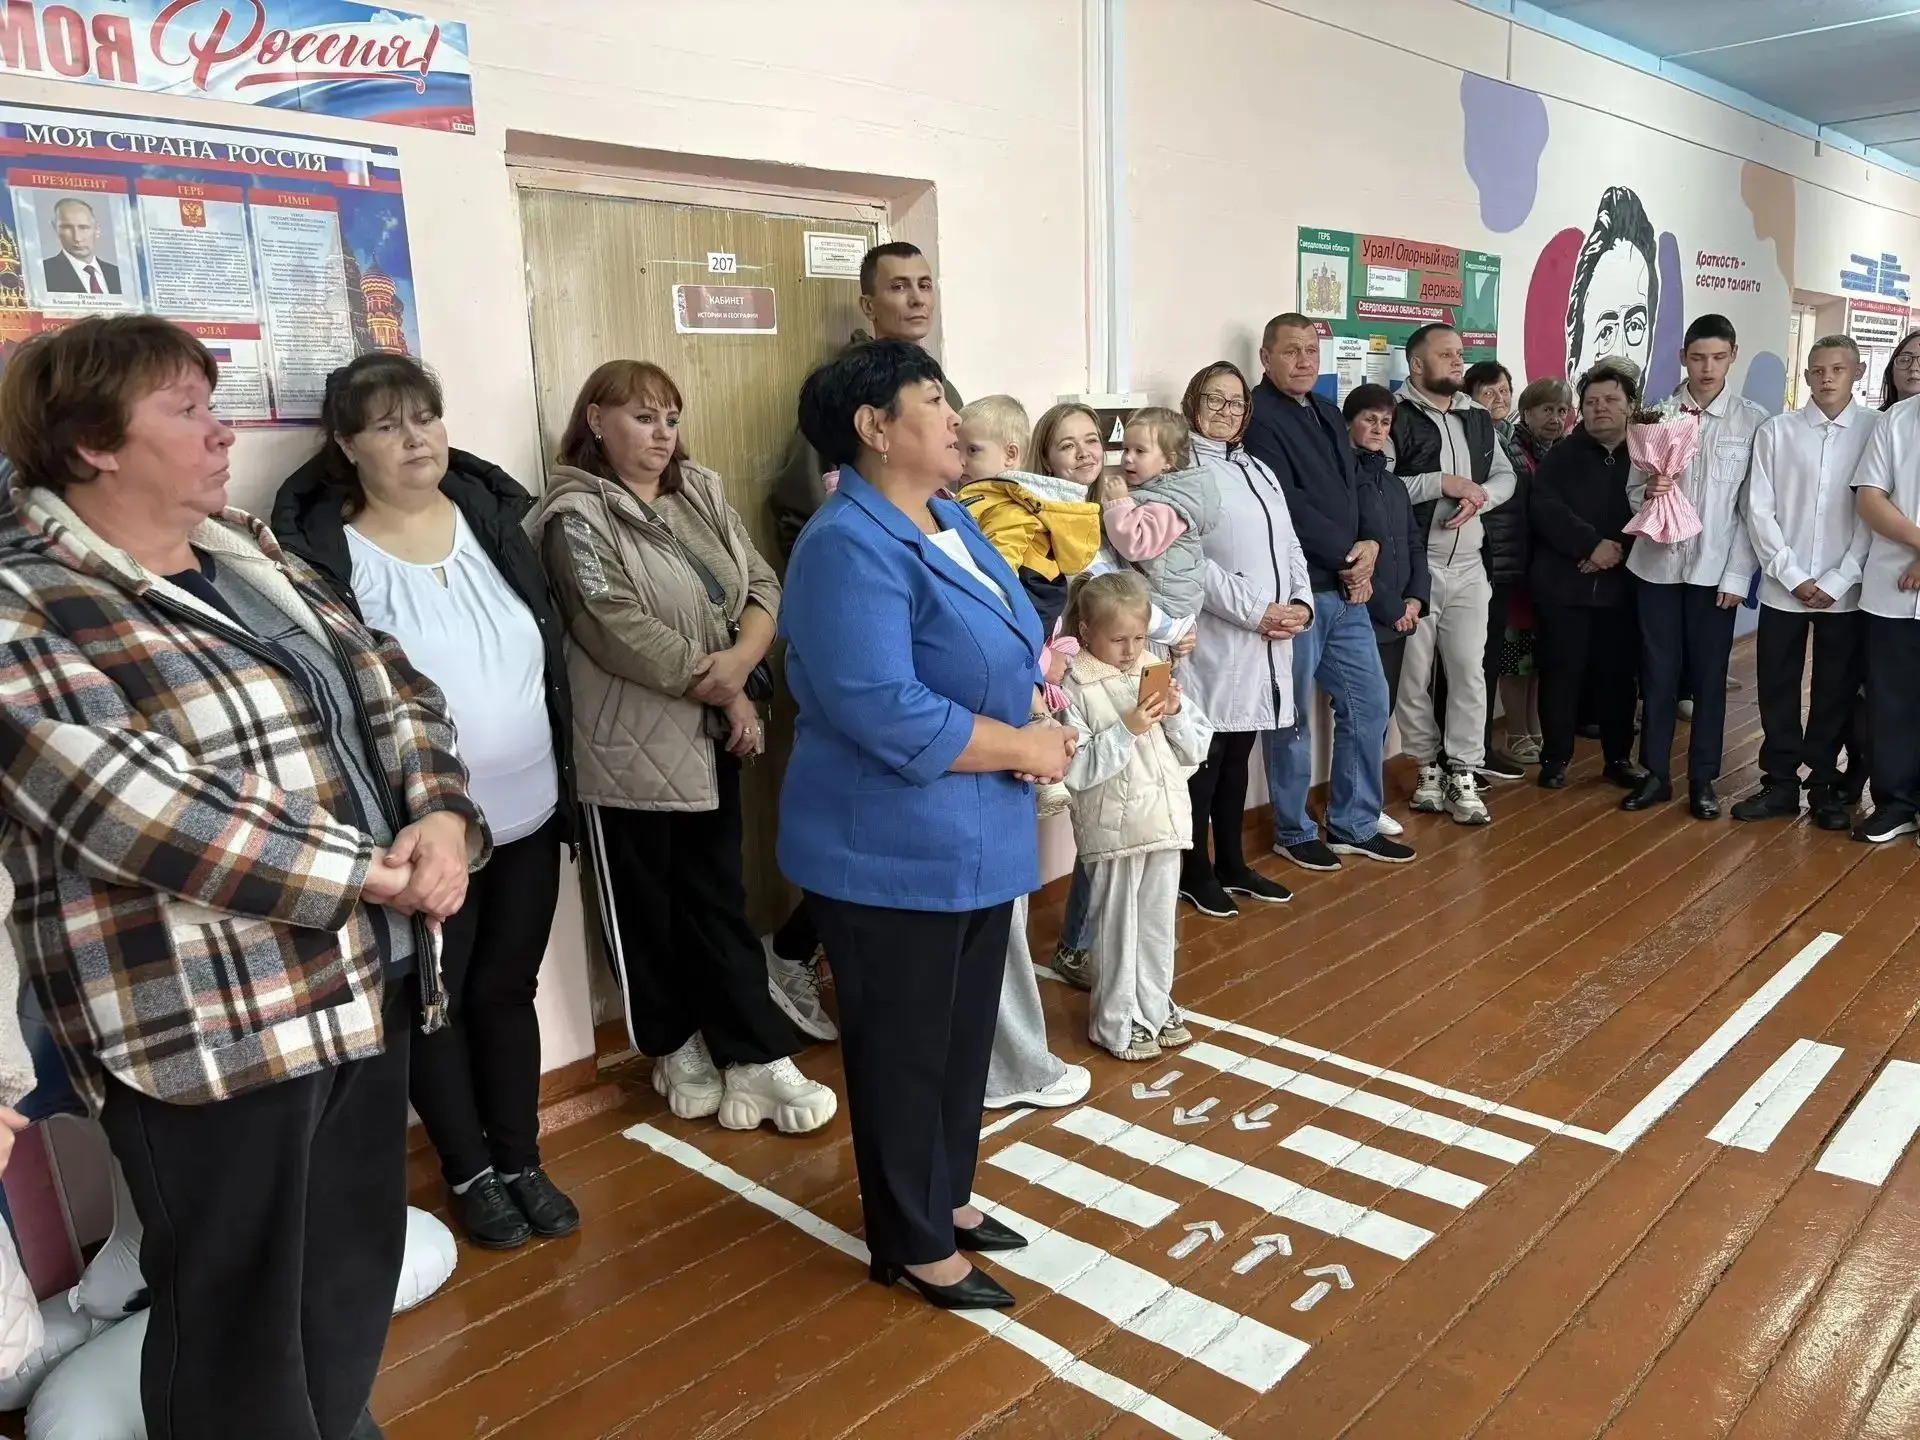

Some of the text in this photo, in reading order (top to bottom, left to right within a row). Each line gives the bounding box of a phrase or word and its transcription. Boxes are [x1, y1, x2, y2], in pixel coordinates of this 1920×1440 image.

[150, 0, 440, 92] Россия!
[24, 122, 328, 172] МОЯ СТРАНА РОССИЯ
[32, 174, 107, 190] ПРЕЗИДЕНТ
[177, 185, 204, 196] ГЕРБ
[278, 194, 311, 206] ГИМН
[1318, 231, 1331, 241] ГЕРБ
[1299, 239, 1350, 253] Свердловской области
[1362, 240, 1460, 272] Урал! Опорный край
[1696, 250, 1739, 269] Краткость
[712, 257, 734, 271] 207
[1695, 274, 1761, 292] сестра таланта
[1420, 282, 1463, 300] державы
[709, 296, 745, 305] КАБИНЕТ
[728, 312, 759, 320] ГЕОГРАФИИ
[1399, 305, 1421, 316] ОБЛАСТЬ
[1422, 307, 1444, 318] СЕГОДНЯ
[196, 326, 229, 335] ФЛАГ
